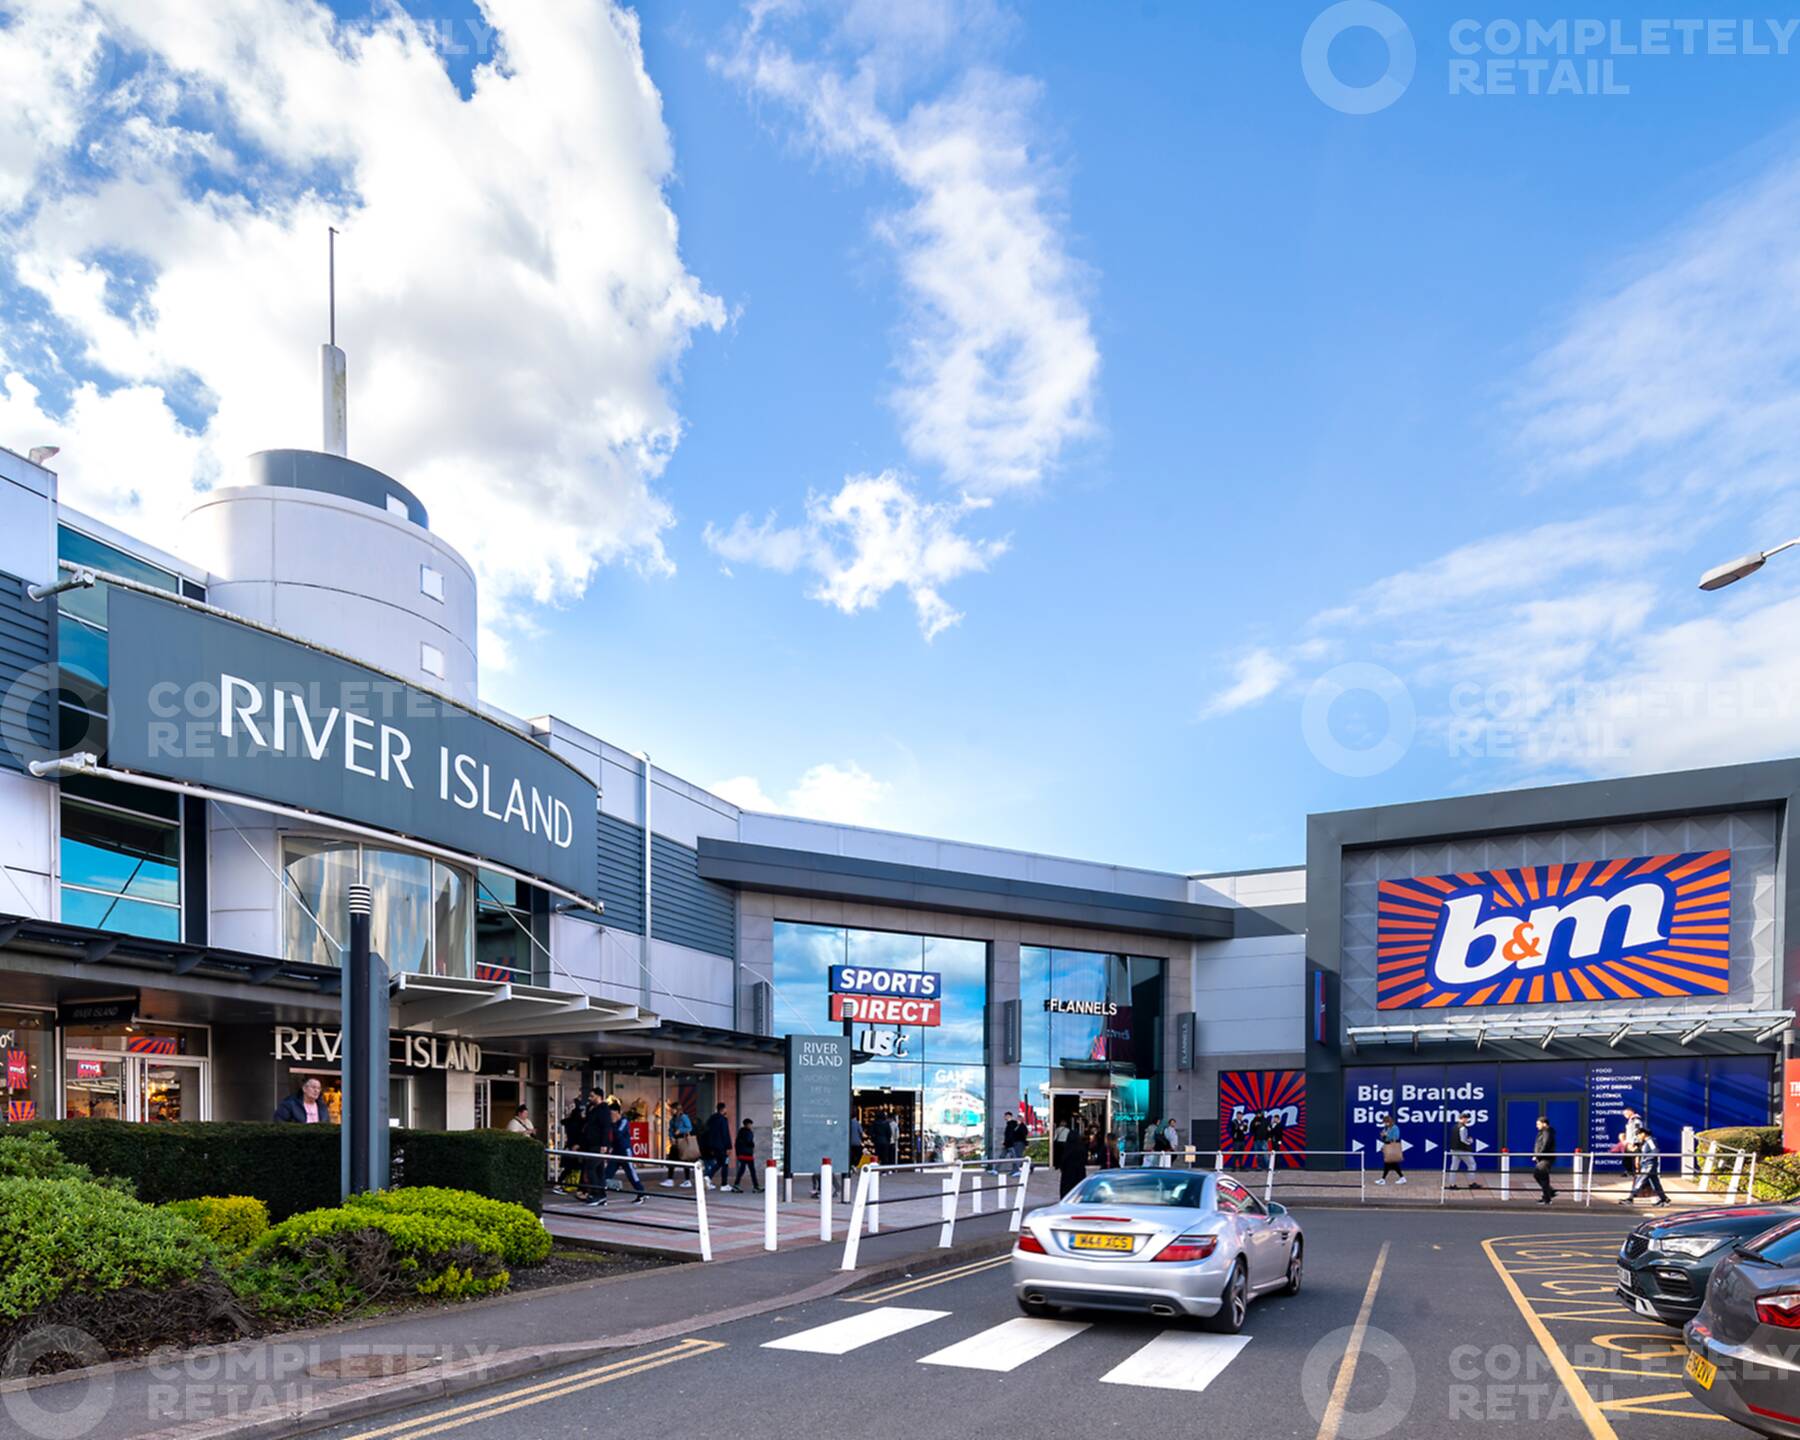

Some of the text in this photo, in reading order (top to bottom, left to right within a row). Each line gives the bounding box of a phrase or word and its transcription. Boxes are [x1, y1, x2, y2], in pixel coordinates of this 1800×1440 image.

[220, 672, 573, 849] RIVER ISLAND
[1433, 882, 1669, 986] b&m
[840, 968, 936, 995] SPORTS
[840, 997, 935, 1023] DIRECT
[1050, 997, 1118, 1016] FLANNELS
[274, 1025, 482, 1073] RIV ISLAND
[803, 1041, 838, 1055] RIVER
[861, 1030, 910, 1059] USC
[798, 1054, 843, 1068] ISLAND
[1357, 1082, 1485, 1105] Big Brands
[1353, 1105, 1489, 1128] Big Savings
